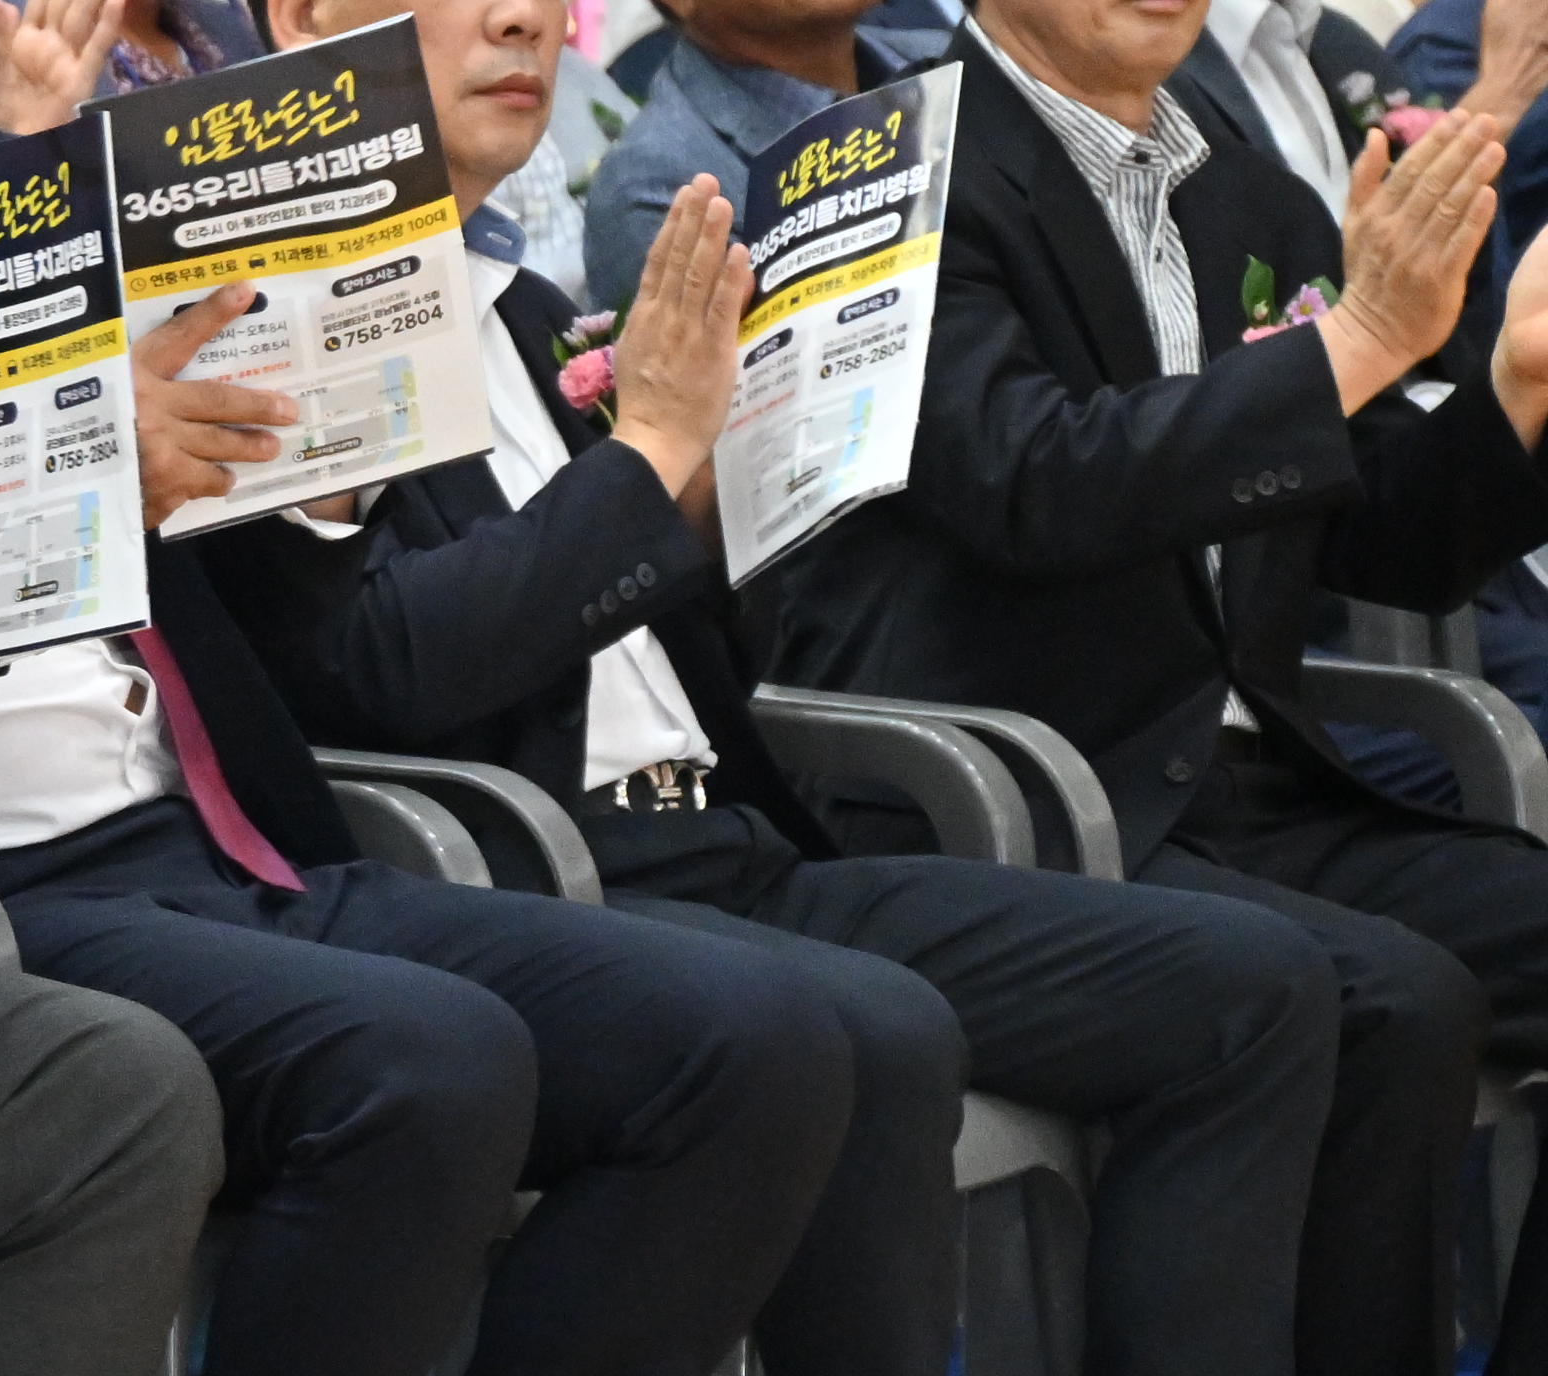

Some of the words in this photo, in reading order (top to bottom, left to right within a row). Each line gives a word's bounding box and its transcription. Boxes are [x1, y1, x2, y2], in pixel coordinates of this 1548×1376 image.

[163, 69, 360, 166] 임플란트는?
[122, 123, 425, 222] 365우리들치과병원
[776, 110, 903, 208] 임플란트는?
[344, 305, 445, 349] 758-2804
[835, 339, 907, 376] 758-2804
[59, 440, 120, 471] 758-2804
